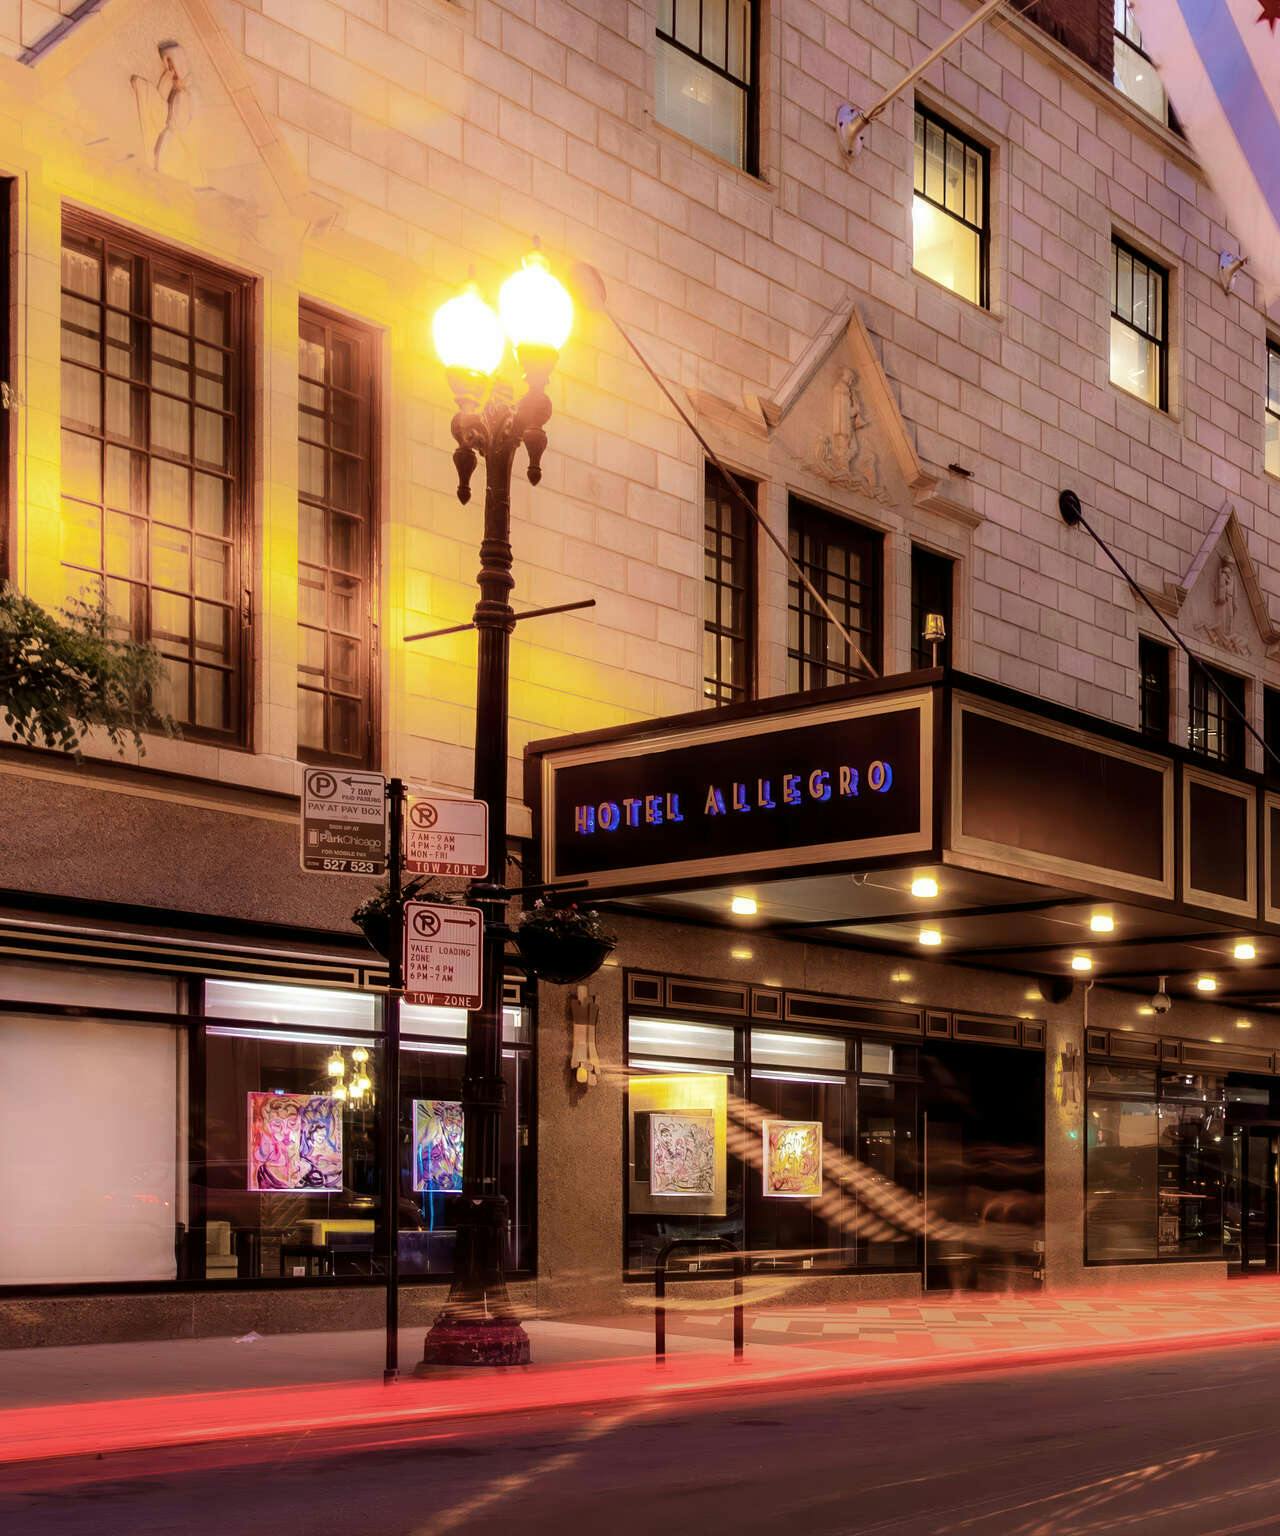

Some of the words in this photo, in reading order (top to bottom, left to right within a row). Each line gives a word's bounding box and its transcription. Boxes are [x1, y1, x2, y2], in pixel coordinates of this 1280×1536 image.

[358, 788, 373, 796] DAY
[575, 792, 684, 835] HOTEL
[704, 759, 893, 815] ALLEGRO
[308, 803, 326, 811] PAY
[327, 804, 338, 812] AT
[341, 806, 359, 814] PAY
[361, 808, 381, 816] BOX
[323, 859, 347, 871] 527
[350, 861, 374, 873] 523
[416, 862, 440, 873] TOW
[446, 864, 477, 876] ZONE
[411, 944, 433, 953] VALET
[439, 946, 471, 957] LOADING
[410, 954, 430, 962] ZONE
[413, 992, 434, 1004] TOW
[444, 995, 472, 1007] ZONE
